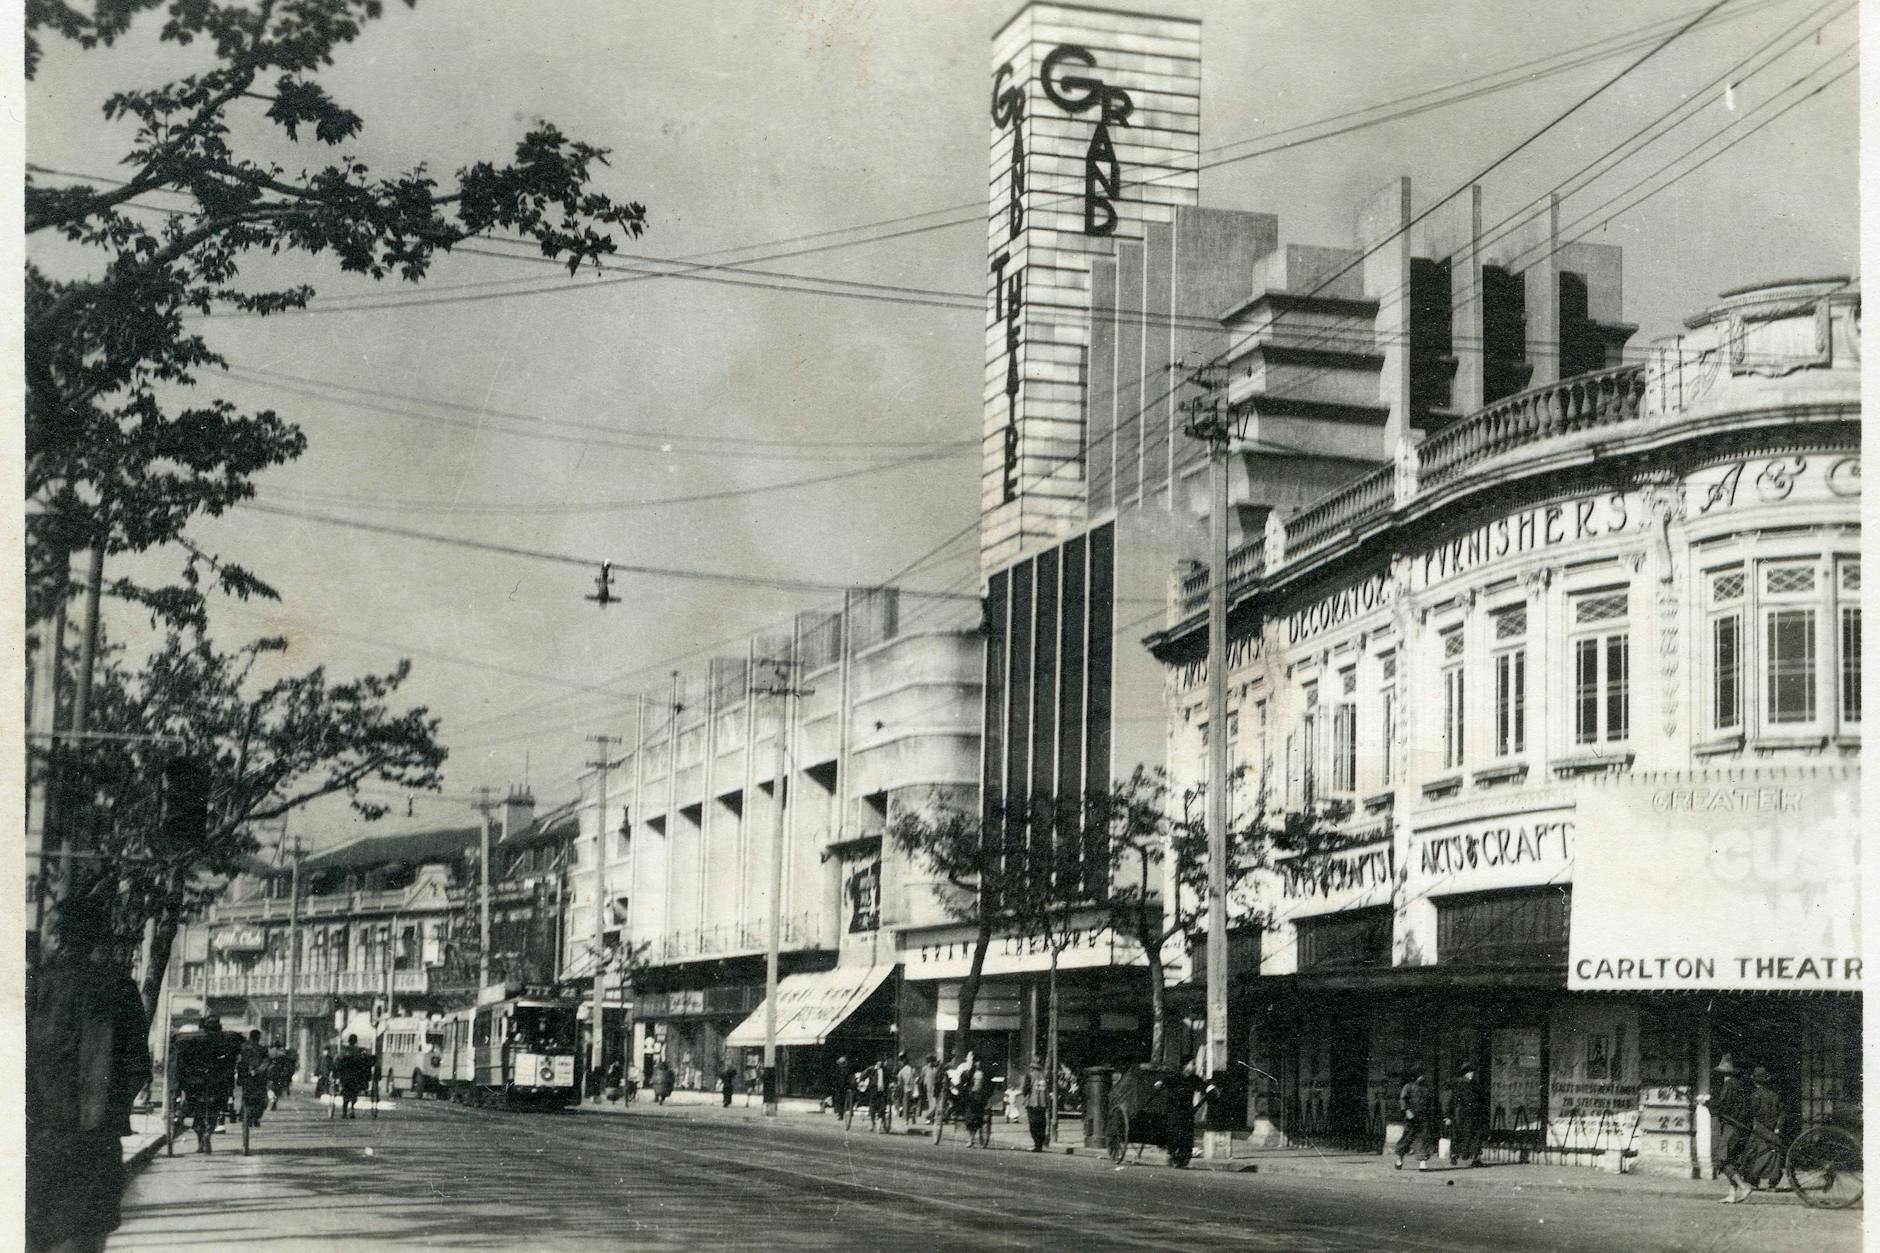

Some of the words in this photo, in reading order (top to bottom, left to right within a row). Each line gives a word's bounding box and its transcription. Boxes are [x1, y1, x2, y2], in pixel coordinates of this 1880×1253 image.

[991, 62, 1026, 240] GRAND
[1041, 44, 1134, 236] GRAND
[991, 251, 1022, 504] THEATRE
[1421, 833, 1464, 875] ARTS
[1465, 833, 1480, 870] &
[1482, 822, 1576, 867] CRAFT
[1651, 786, 1803, 814] GREATER
[1576, 957, 1716, 981] CARLTON
[1734, 956, 1863, 981] THEATR
